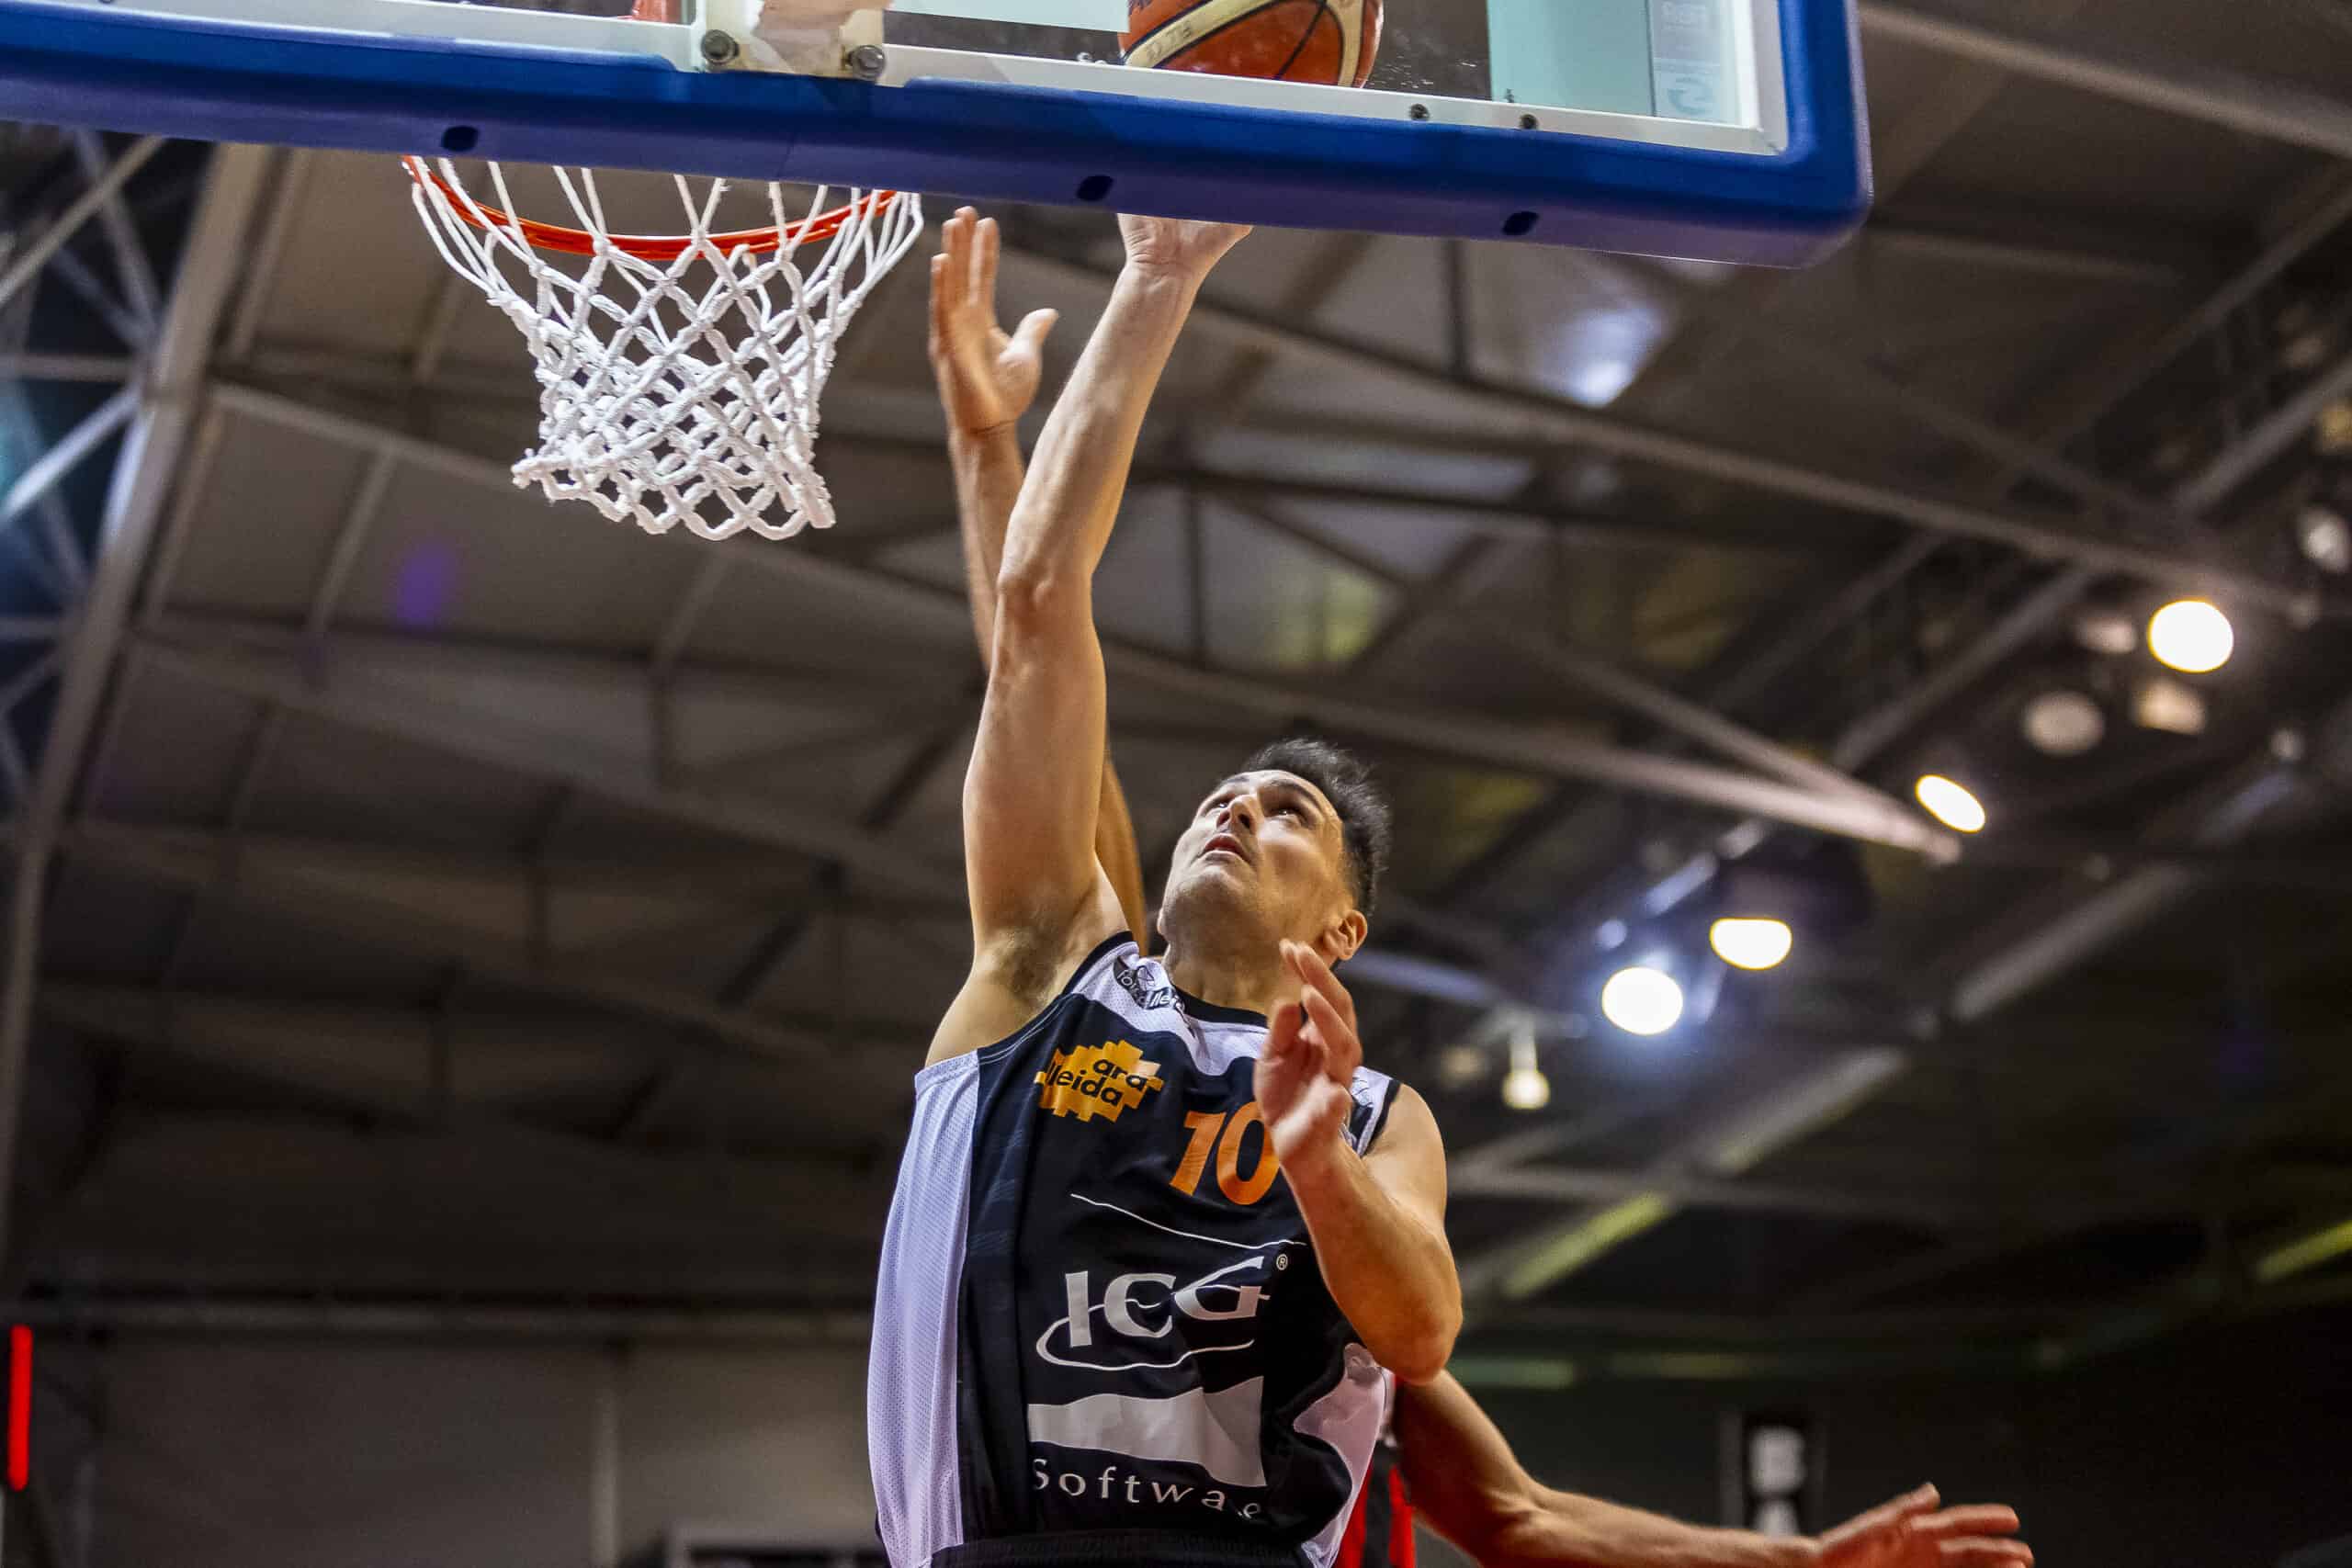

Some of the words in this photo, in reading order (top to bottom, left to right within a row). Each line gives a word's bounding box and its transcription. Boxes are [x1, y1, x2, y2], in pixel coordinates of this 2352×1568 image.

[1092, 1059, 1148, 1091] ara
[1170, 1101, 1281, 1205] 10
[1033, 1458, 1261, 1519] Softwae
